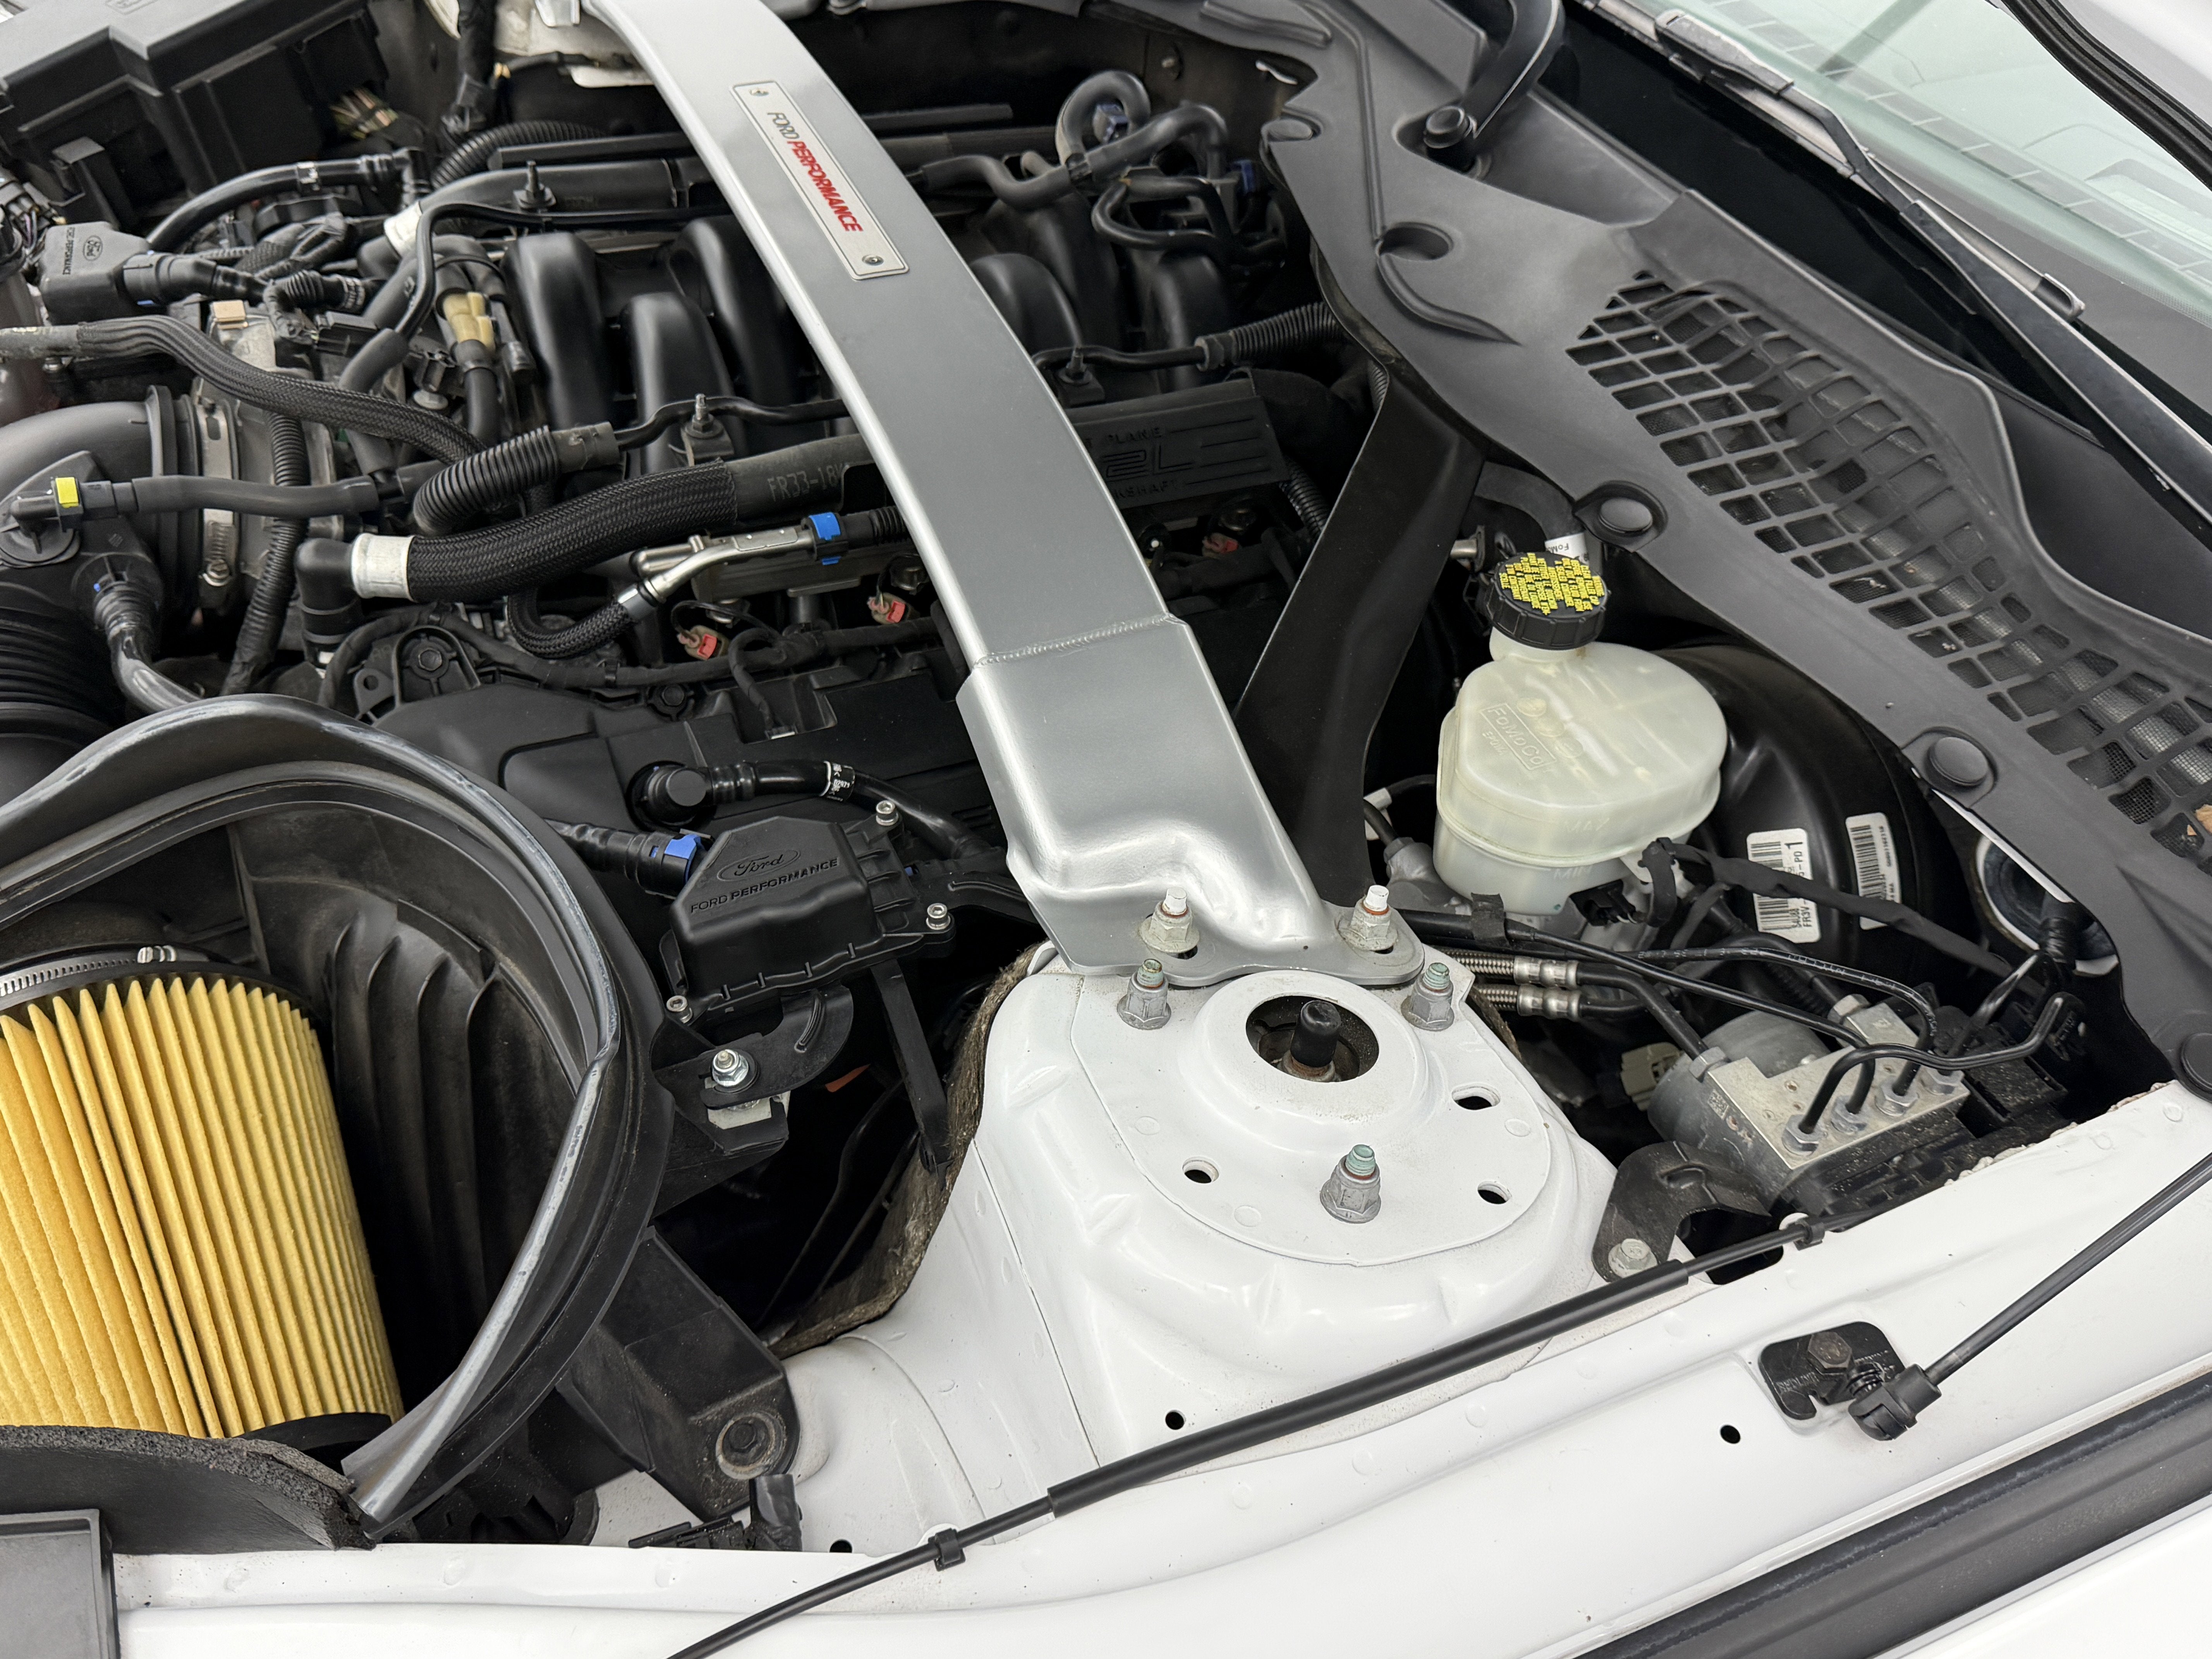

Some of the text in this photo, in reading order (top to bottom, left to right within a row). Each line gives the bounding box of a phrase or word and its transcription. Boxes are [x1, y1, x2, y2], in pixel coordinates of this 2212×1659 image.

[767, 112, 864, 232] FORD PERFORMANCE
[1546, 543, 1569, 554] FoM
[1487, 708, 1544, 765] FoMoCo
[691, 857, 839, 913] FORD PERFORMANCE
[734, 854, 785, 877] Ford
